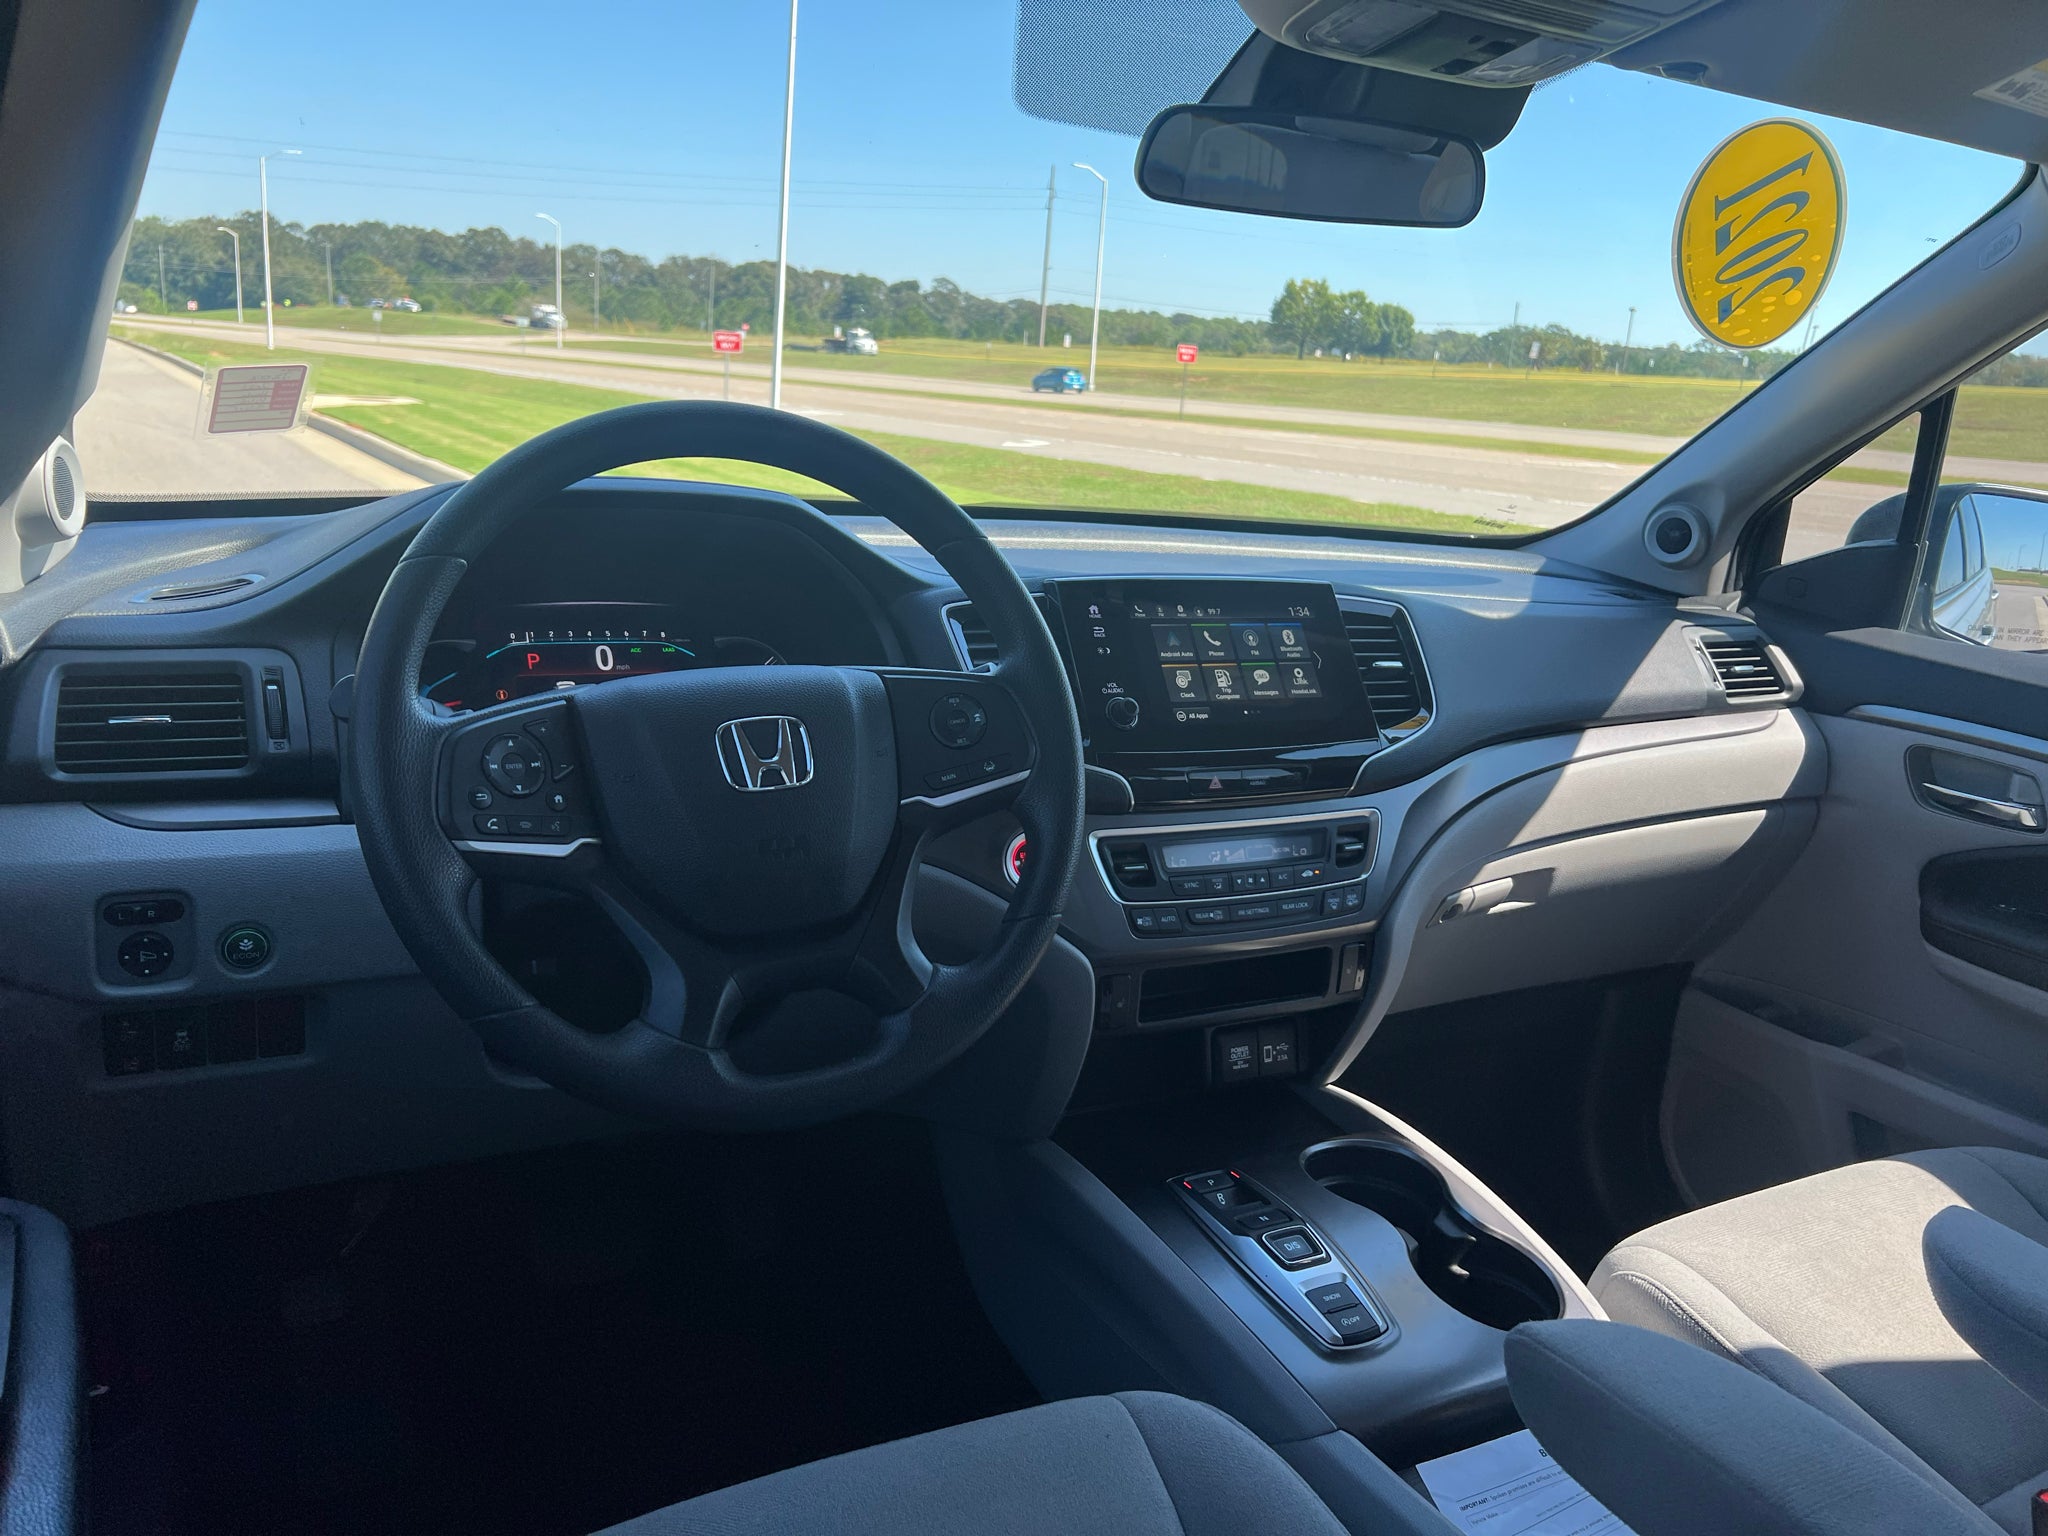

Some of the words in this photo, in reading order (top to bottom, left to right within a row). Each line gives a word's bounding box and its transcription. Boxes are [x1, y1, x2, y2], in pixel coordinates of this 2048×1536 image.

[1288, 605, 1310, 617] 1:34
[509, 632, 516, 640] 0
[527, 653, 540, 670] P
[595, 645, 614, 671] 0
[1254, 672, 1268, 680] SMS
[1221, 687, 1232, 695] Trip
[1253, 689, 1279, 697] Messages
[1291, 688, 1317, 696] HondaLink
[1216, 693, 1241, 701] Computer
[1196, 712, 1209, 720] Apps
[941, 773, 957, 781] MAIN
[1184, 882, 1200, 890] SYNC
[1247, 907, 1270, 916] SETTINGS
[233, 951, 260, 961] ECON
[1230, 1045, 1249, 1053] POWER
[1230, 1050, 1250, 1059] OUTLET
[1216, 1193, 1225, 1202] R
[1284, 1241, 1301, 1251] D/S
[1322, 1293, 1341, 1302] SNOW
[1349, 1315, 1361, 1325] OFF
[1507, 1483, 1528, 1498] promises
